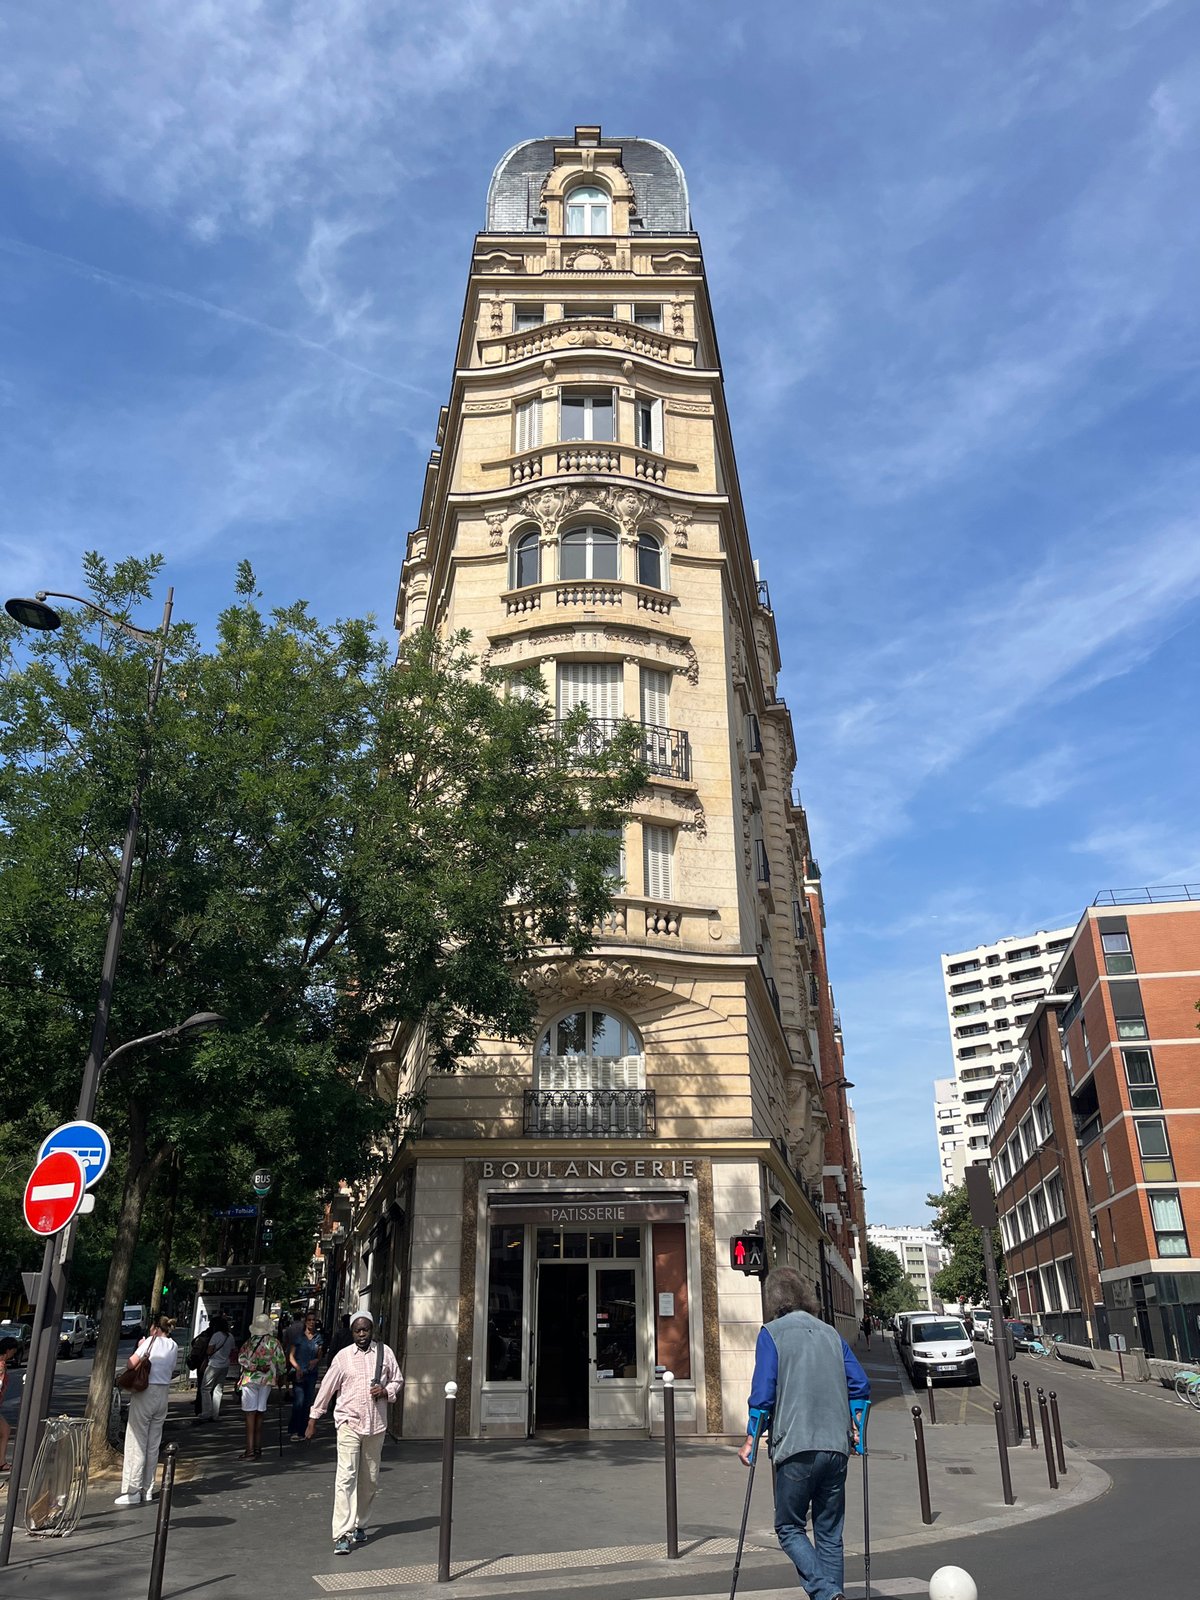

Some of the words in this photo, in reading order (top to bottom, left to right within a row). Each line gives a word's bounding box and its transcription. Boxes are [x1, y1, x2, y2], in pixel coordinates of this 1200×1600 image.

[483, 1160, 695, 1178] BOULANGERIE
[254, 1174, 271, 1184] BUS
[551, 1207, 626, 1222] PATISSERIE
